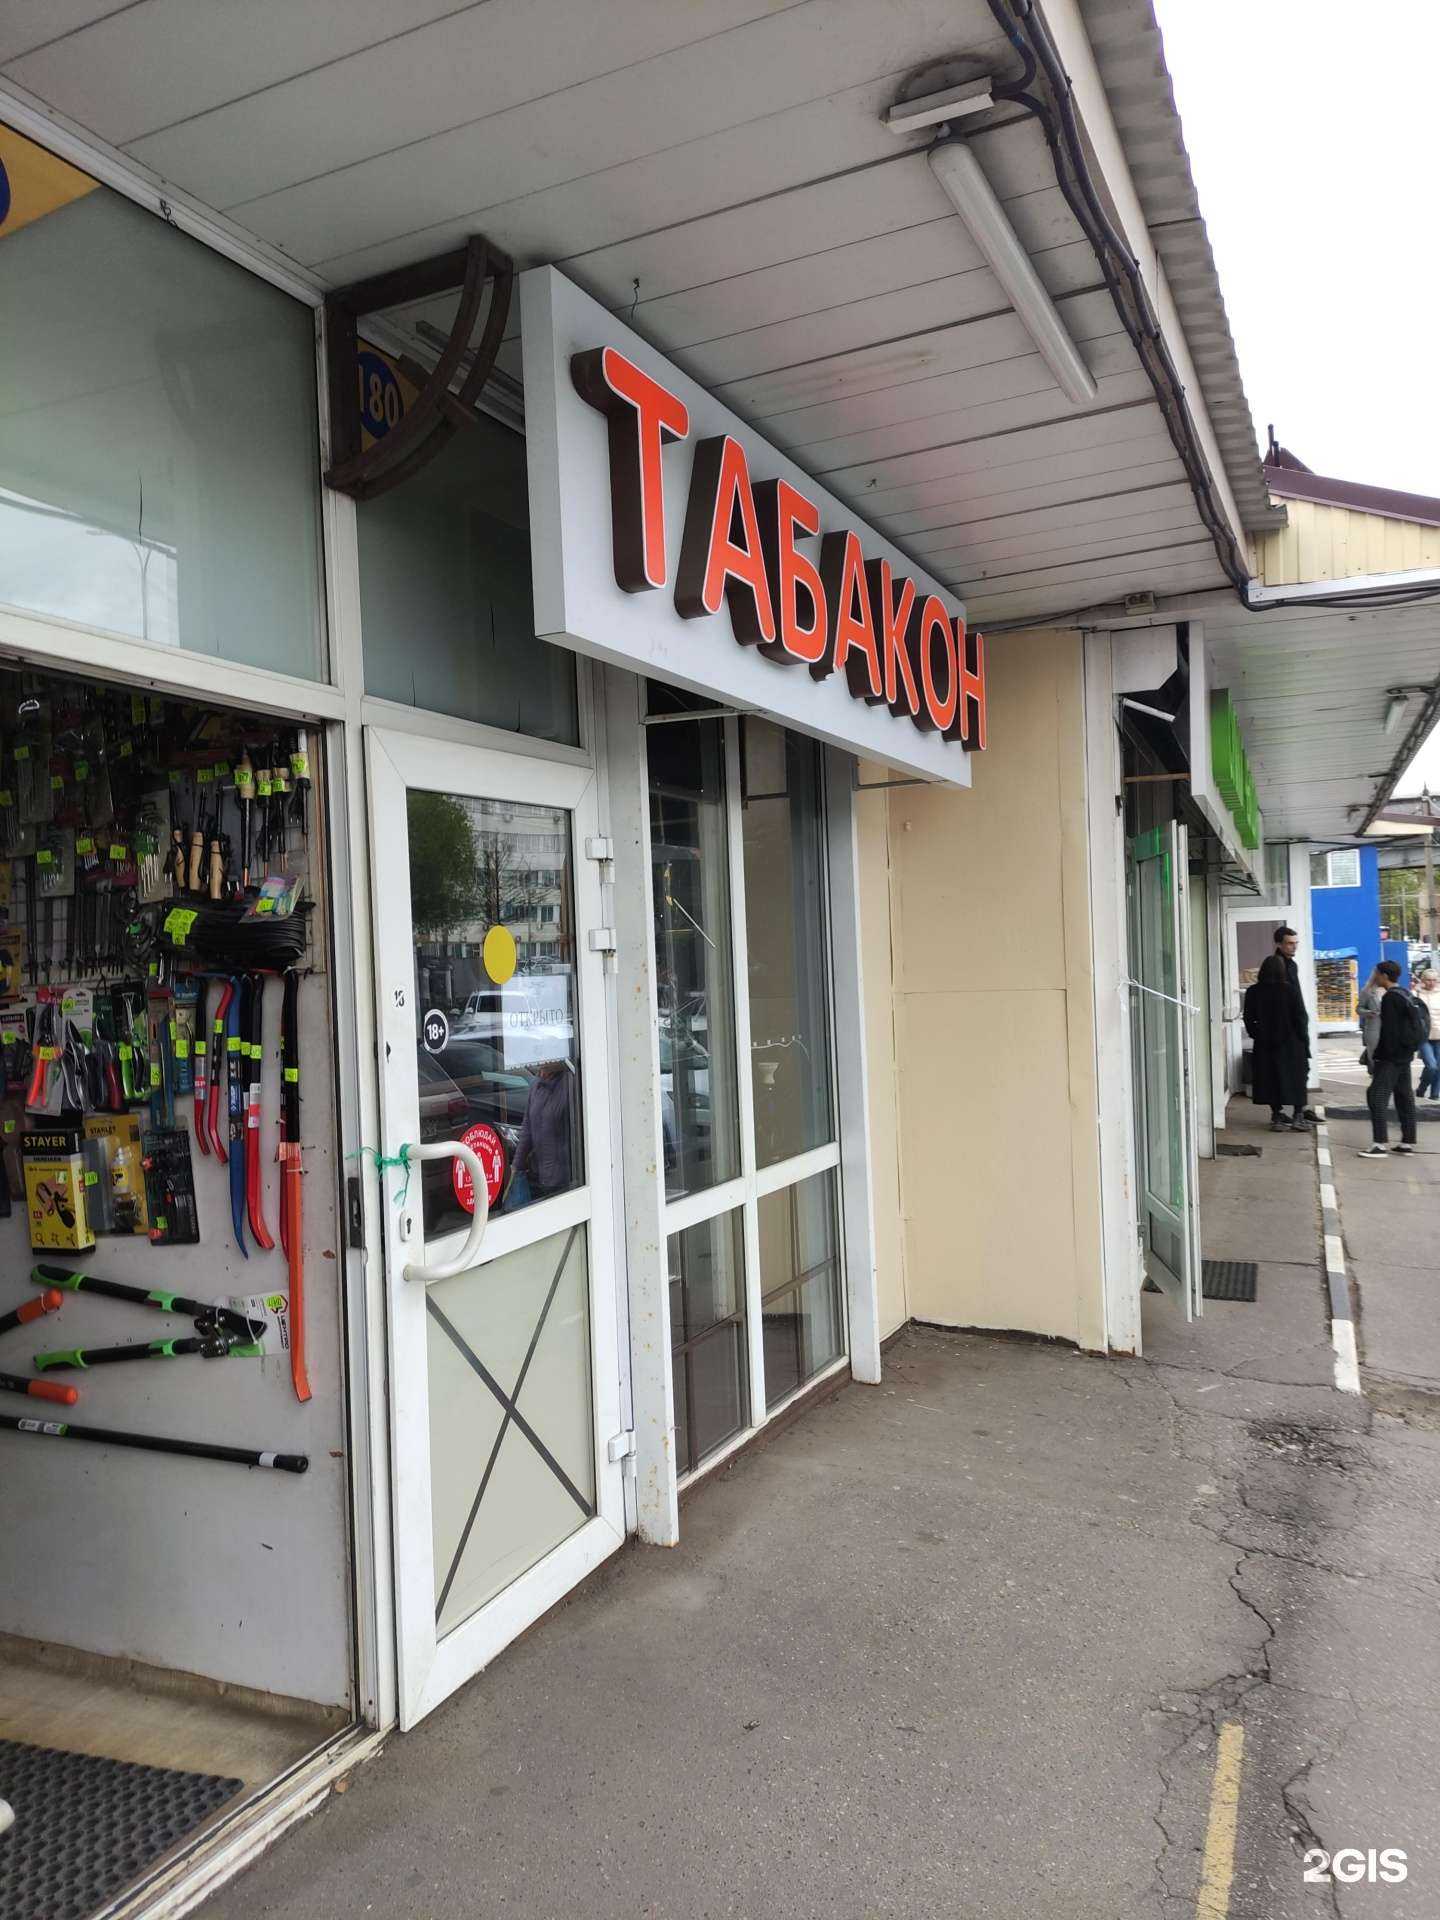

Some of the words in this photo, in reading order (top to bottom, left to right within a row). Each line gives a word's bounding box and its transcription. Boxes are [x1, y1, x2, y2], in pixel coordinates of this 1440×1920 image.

[572, 345, 987, 751] ТАБАКОН
[426, 1023, 445, 1041] 18+
[23, 1135, 67, 1148] STAYER
[462, 1129, 497, 1147] ОБЛЮДАЙ
